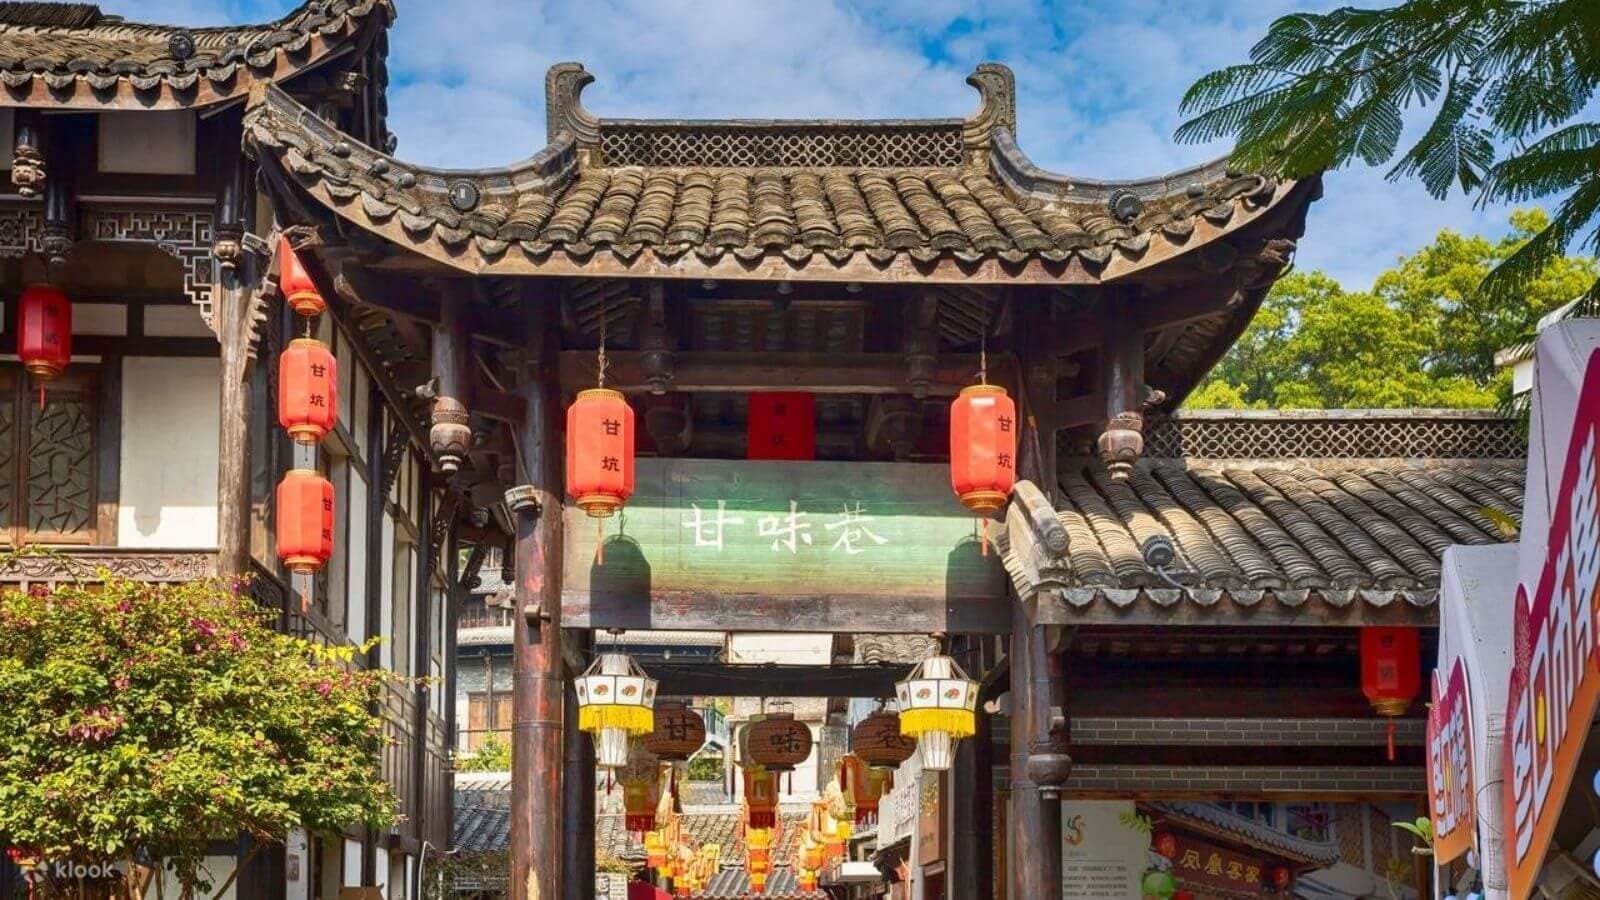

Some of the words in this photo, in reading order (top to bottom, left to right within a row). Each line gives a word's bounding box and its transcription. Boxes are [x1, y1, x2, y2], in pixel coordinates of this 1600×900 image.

[310, 363, 326, 408] 甘坑
[601, 418, 622, 474] 甘坑
[997, 415, 1013, 470] 甘坑
[682, 499, 888, 556] 甘味巷
[665, 716, 693, 740] 甘
[770, 726, 800, 753] 味
